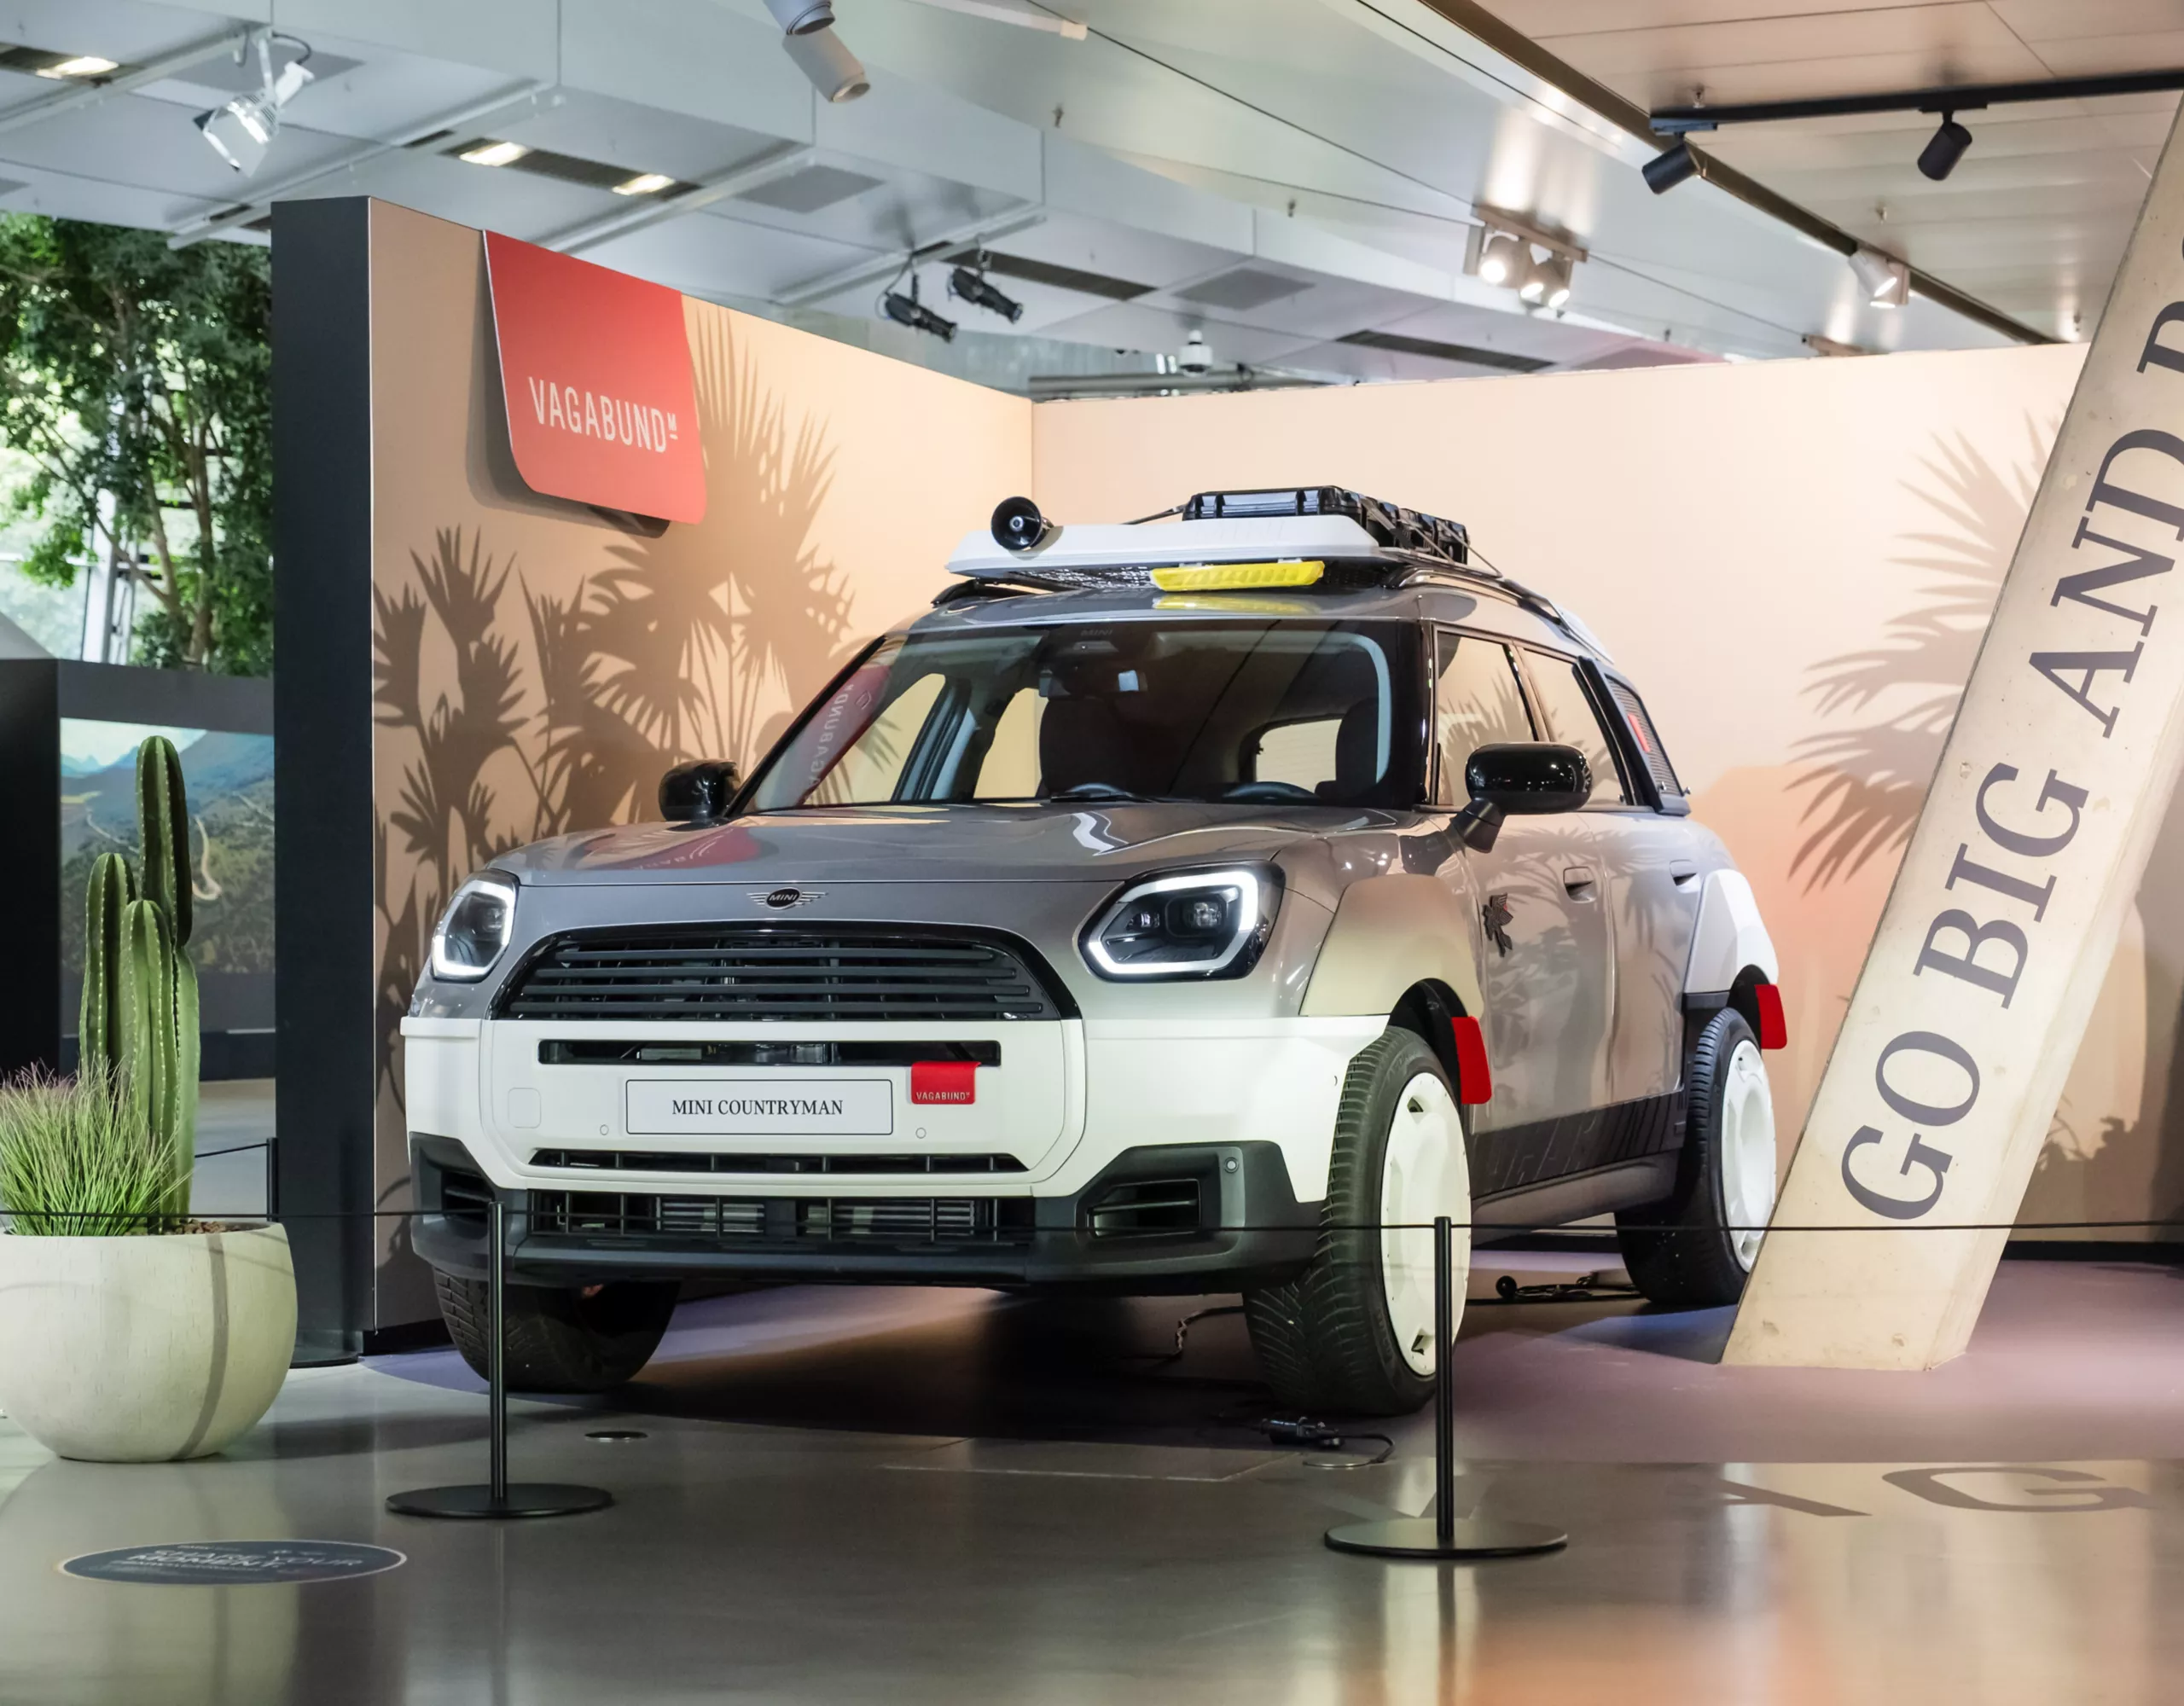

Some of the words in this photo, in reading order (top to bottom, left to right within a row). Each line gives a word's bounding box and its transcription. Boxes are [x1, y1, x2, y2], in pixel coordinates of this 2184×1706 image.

[1840, 1029, 1980, 1220] GO
[1912, 762, 2090, 1009] BIG
[2028, 428, 2184, 739] AND
[769, 893, 799, 902] MINI
[671, 1099, 713, 1117] MINI
[717, 1099, 843, 1117] COUNTRYMAN
